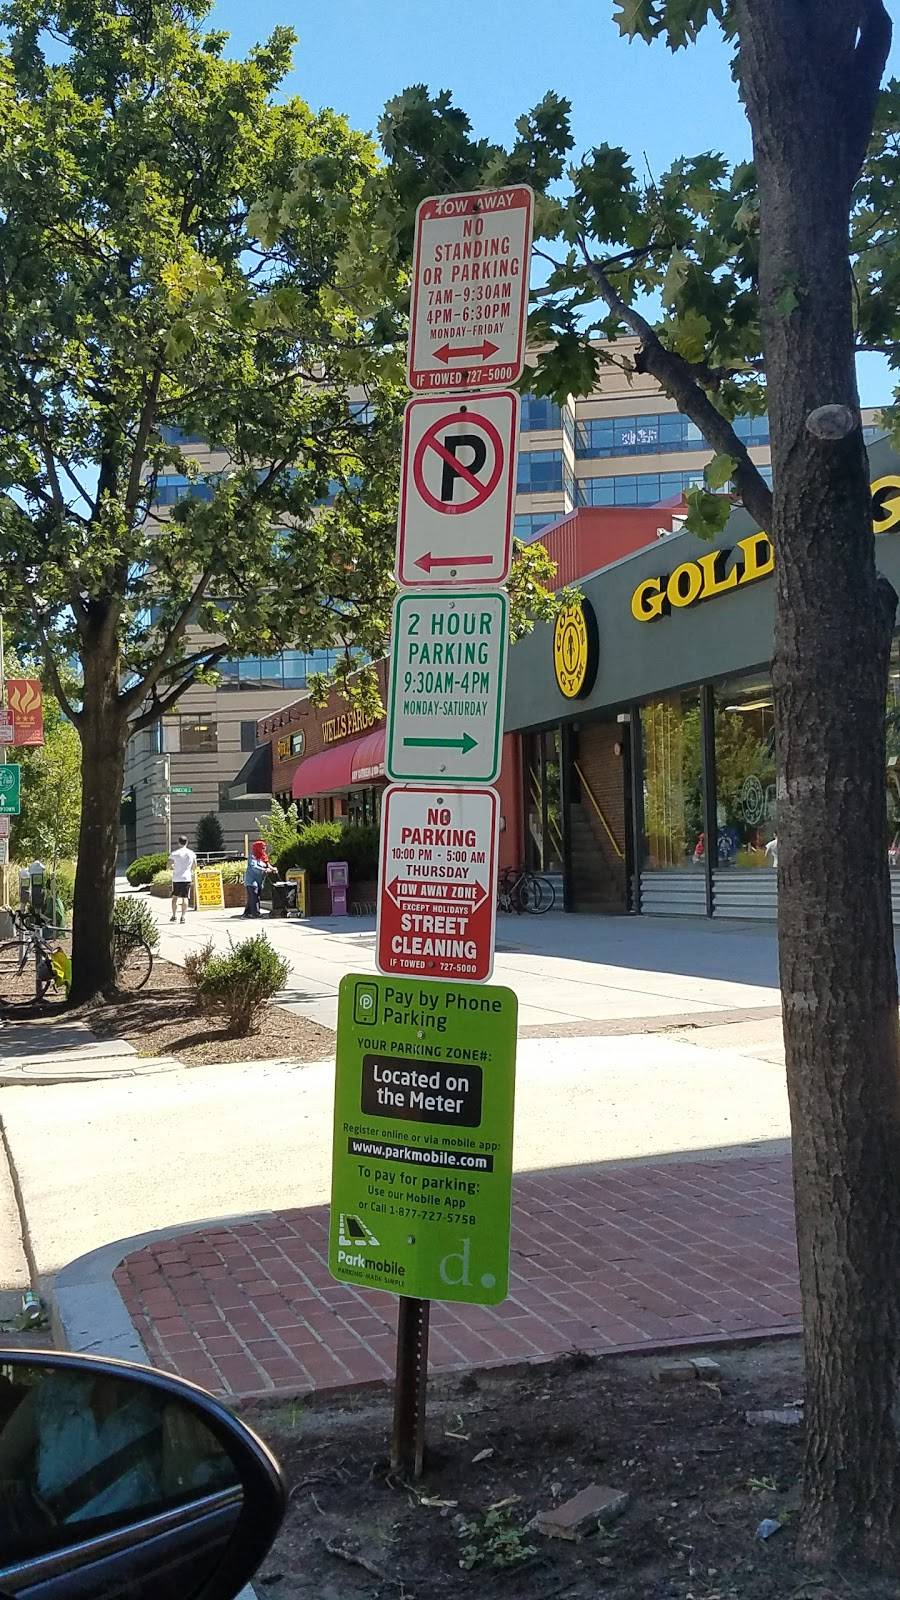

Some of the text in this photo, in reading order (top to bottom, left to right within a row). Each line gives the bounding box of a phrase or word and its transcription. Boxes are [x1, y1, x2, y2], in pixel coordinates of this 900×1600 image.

[436, 193, 514, 215] TOW AWAY
[463, 218, 484, 237] NO
[435, 237, 510, 262] STANDING
[423, 258, 519, 285] OR PARKING
[428, 283, 511, 305] 7AM-9:30AM
[427, 302, 510, 325] 4PM-6:30PM
[430, 322, 504, 339] MONDAY-FRIDAY
[416, 367, 512, 387] IF TOWED 727-5000
[408, 613, 492, 635] 2 HOUR
[408, 643, 488, 664] PARKING
[404, 672, 489, 694] 9:30AM-4PM
[403, 701, 488, 716] MONDAY-SATURDAY
[321, 709, 375, 743] WELLS FARGO
[427, 808, 451, 826] NO
[401, 828, 476, 848] PARKING
[392, 848, 415, 861] 10:00
[418, 849, 432, 861] PM
[446, 850, 467, 863] 5:00
[470, 851, 486, 864] AM
[406, 864, 470, 879] THURSDAY
[396, 883, 477, 899] TOW AWAY ZONE
[402, 903, 469, 915] EXCEPT HOLIDAYS
[401, 914, 468, 935] STREET
[392, 935, 477, 959] CLEANING
[390, 958, 477, 973] IF TOWED 727-5000
[385, 987, 502, 1013] Pay by Phone
[384, 1008, 447, 1032] Parking
[357, 1037, 492, 1062] YOUR PARKING ZONE#:
[373, 1064, 469, 1093] Located on
[377, 1087, 464, 1114] the Meter
[343, 1122, 379, 1137] Register
[381, 1129, 409, 1141] online
[411, 1134, 421, 1142] or
[424, 1134, 439, 1145] via
[442, 1136, 476, 1149] mobile
[352, 1141, 488, 1169] www.parkmobile.com
[358, 1165, 480, 1195] To pay for parking:
[367, 1185, 466, 1209] Use our Mobile App
[358, 1201, 476, 1226] or Call 1-877-727-5758
[338, 1250, 406, 1276] Parkmobile
